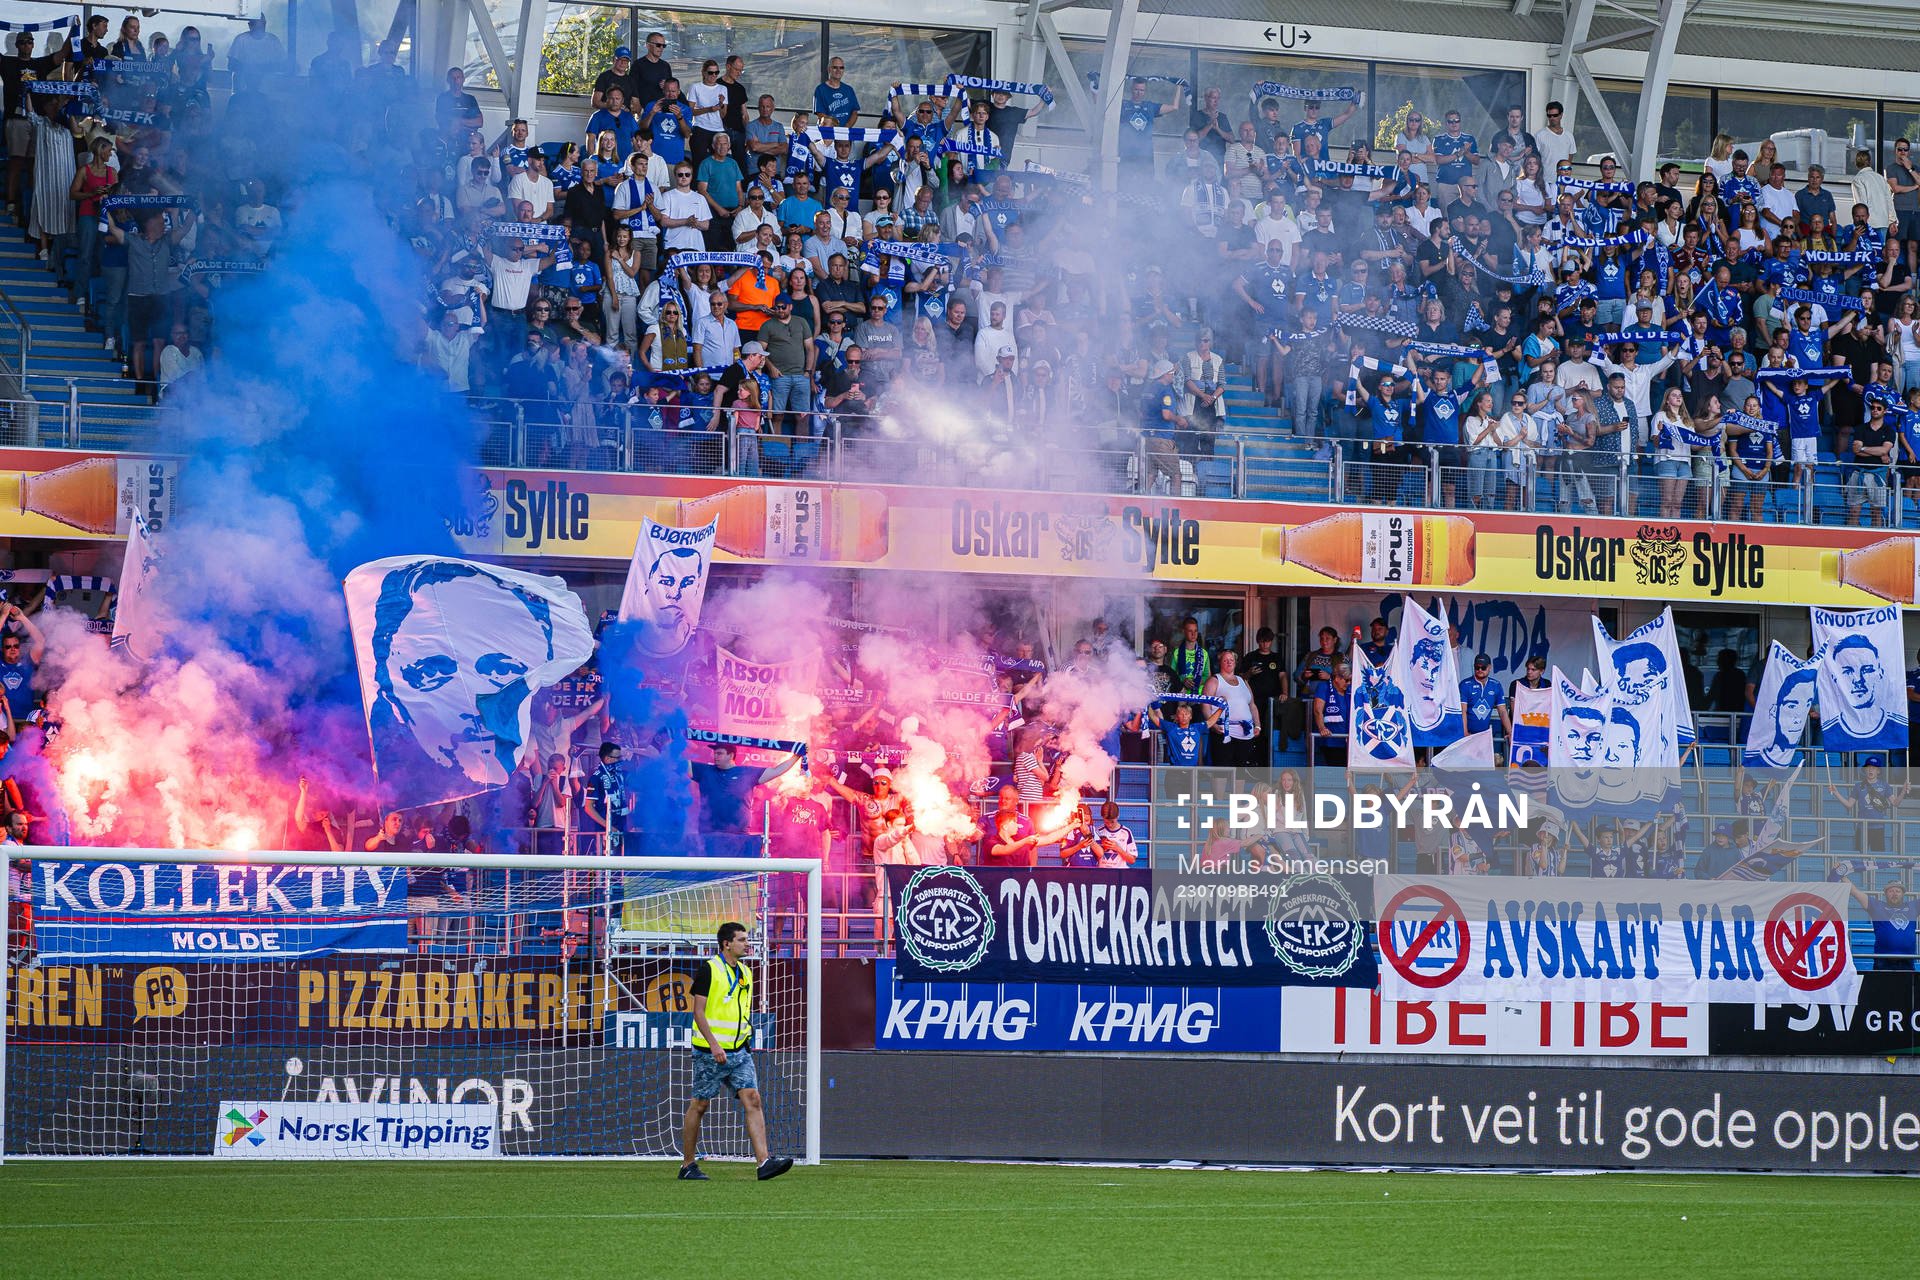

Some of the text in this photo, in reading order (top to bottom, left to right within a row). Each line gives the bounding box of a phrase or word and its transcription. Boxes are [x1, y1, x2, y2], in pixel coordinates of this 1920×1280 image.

[1280, 26, 1295, 48] U
[32, 82, 73, 92] MOLDE
[955, 75, 1035, 94] MOLDE FK
[1279, 87, 1338, 98] MOLDE FK
[82, 102, 156, 125] MLDE FK
[956, 141, 989, 153] MOLDE
[1314, 160, 1385, 177] MOLDE FK
[1610, 181, 1629, 191] FK
[140, 196, 172, 205] MOLDE
[498, 226, 543, 236] MOLDE
[879, 243, 927, 257] MOLDE
[1564, 236, 1629, 247] OLDE FK
[1805, 250, 1873, 262] MOLDE FK
[1781, 287, 1838, 305] MOLDE
[1606, 331, 1669, 340] MOLDE
[1740, 416, 1770, 429] MOLDE
[505, 479, 589, 549] Sylte
[790, 490, 809, 557] brus
[650, 519, 716, 546] BJØRNBAK
[952, 499, 1049, 559] Oskar
[1122, 505, 1200, 573] Sylte
[1384, 517, 1402, 582] brus
[1536, 525, 1625, 582] Oskar
[1693, 532, 1764, 596] Sylte
[1815, 606, 1898, 628] KNUDTZON
[725, 692, 784, 718] MOL
[942, 691, 1000, 704] MOLDE FK
[687, 727, 781, 749] MOLDE FK
[38, 862, 400, 913] KOLLEKTIV
[914, 888, 972, 904] TORNEKRATTET
[1282, 893, 1341, 911] TORNEKRATTET
[1000, 878, 1254, 968] TORNEKRATTET
[172, 931, 280, 951] MOLDE
[914, 933, 978, 951] SUPPORTER
[1282, 941, 1347, 957] SUPPORTER
[1484, 900, 1764, 982] AVSKAFF VAR
[883, 999, 1032, 1042] KPMG
[1070, 1001, 1215, 1043] KPMG
[278, 1116, 493, 1150] Norsk Tipping
[1335, 1085, 1920, 1163] Kort vei til gode opple
